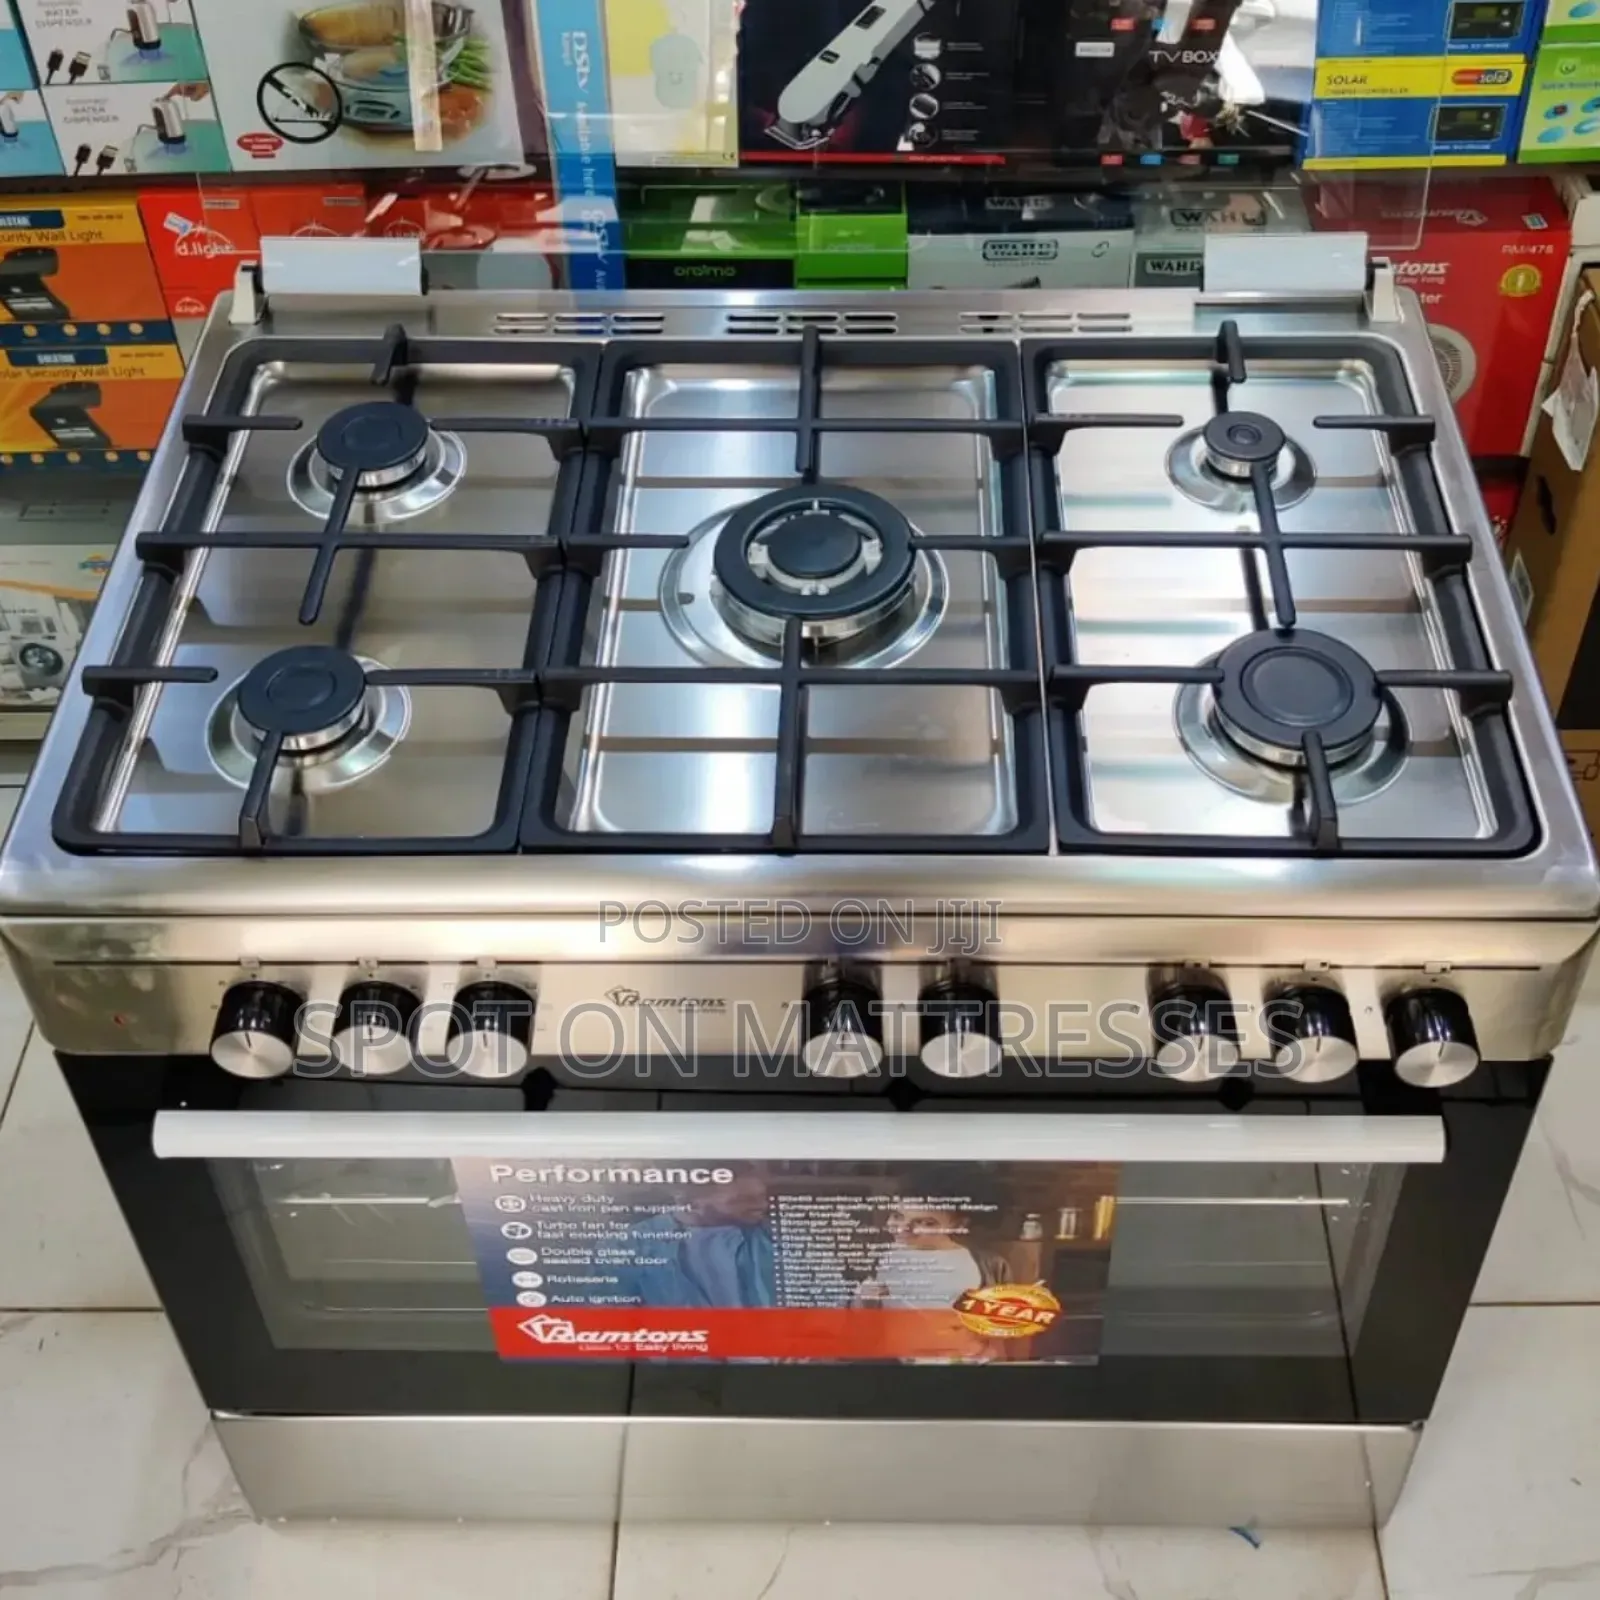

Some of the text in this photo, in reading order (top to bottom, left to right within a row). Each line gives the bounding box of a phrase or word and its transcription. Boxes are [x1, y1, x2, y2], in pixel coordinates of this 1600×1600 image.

[1326, 75, 1367, 85] SOLAR
[70, 229, 104, 242] Light
[489, 1164, 734, 1184] Performance
[529, 1194, 614, 1205] Heavy duty
[633, 1204, 692, 1215] support
[540, 1247, 636, 1259] Double glass
[962, 1300, 1056, 1325] 1 YEAR
[517, 1314, 710, 1345] Ramtons
